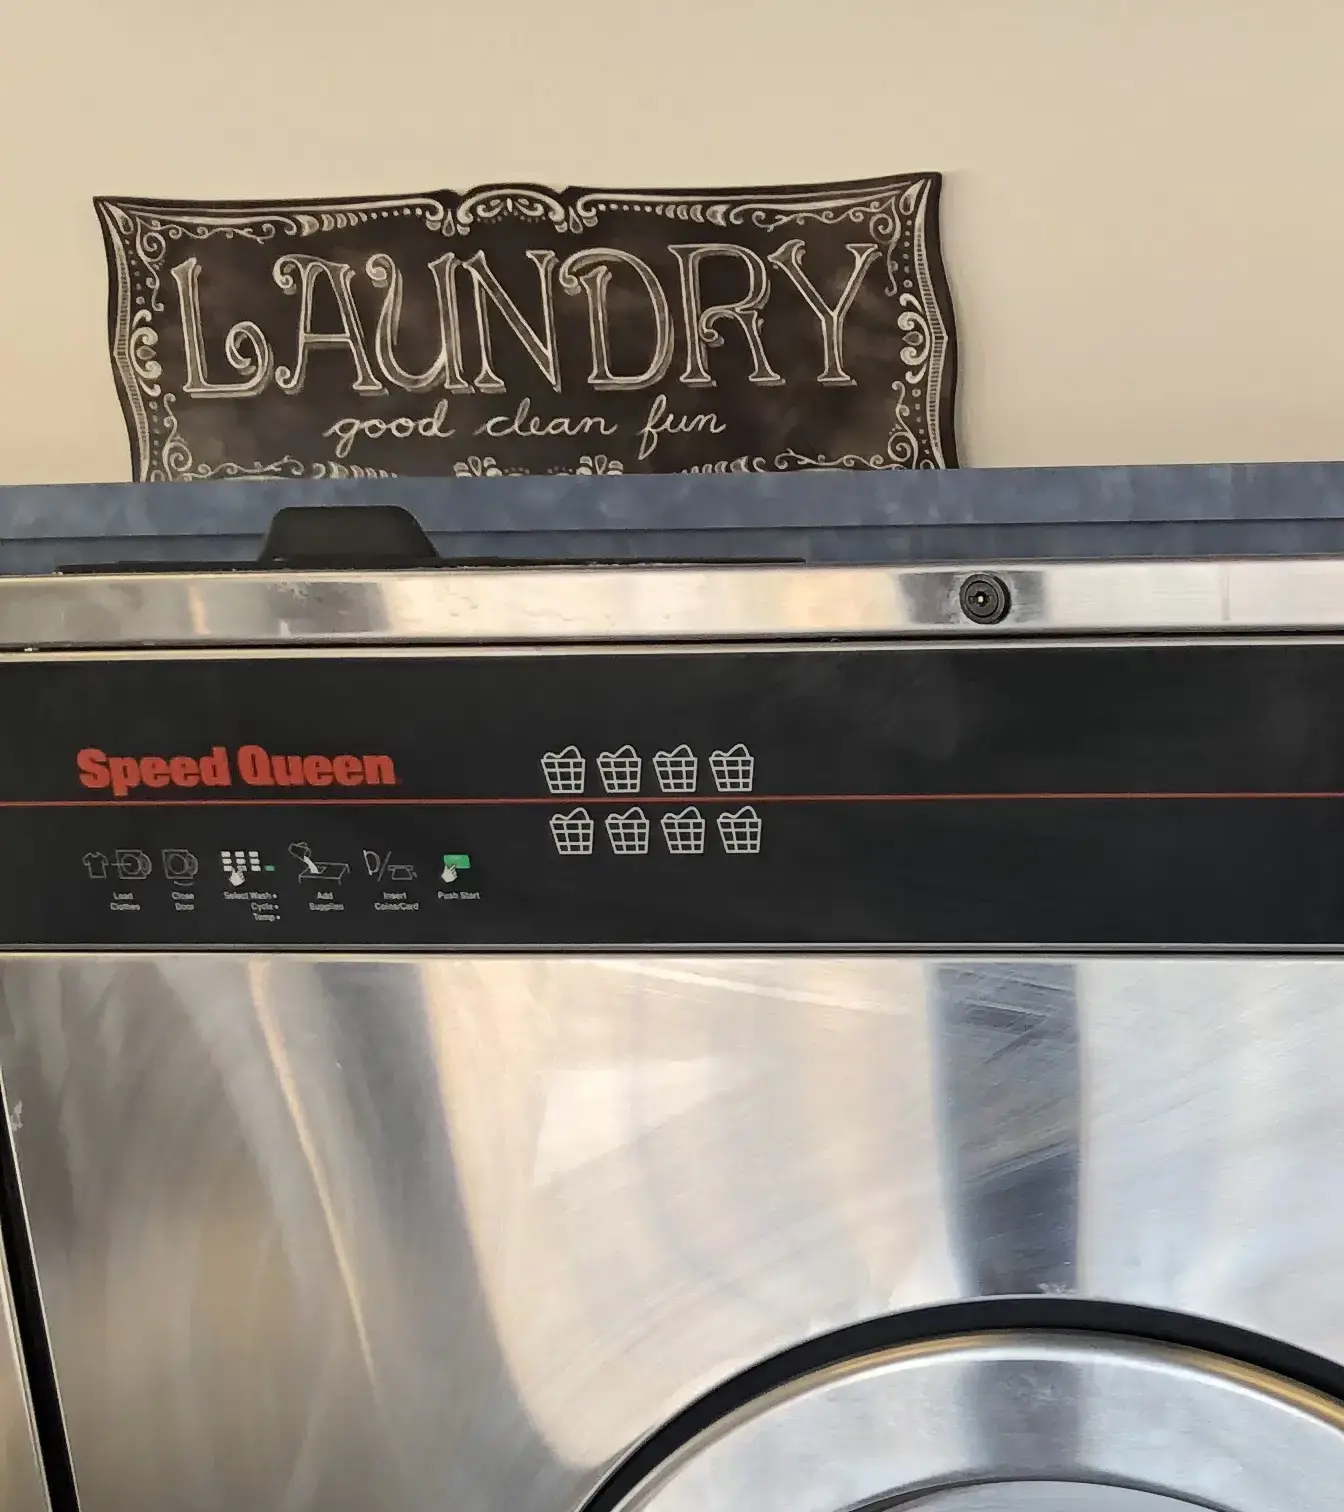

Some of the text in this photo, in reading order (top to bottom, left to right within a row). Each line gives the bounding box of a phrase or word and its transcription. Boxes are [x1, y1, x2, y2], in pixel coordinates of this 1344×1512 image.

[170, 239, 884, 395] LAUNDRY
[322, 397, 728, 461] good clean fun
[77, 745, 396, 796] Speed Queen
